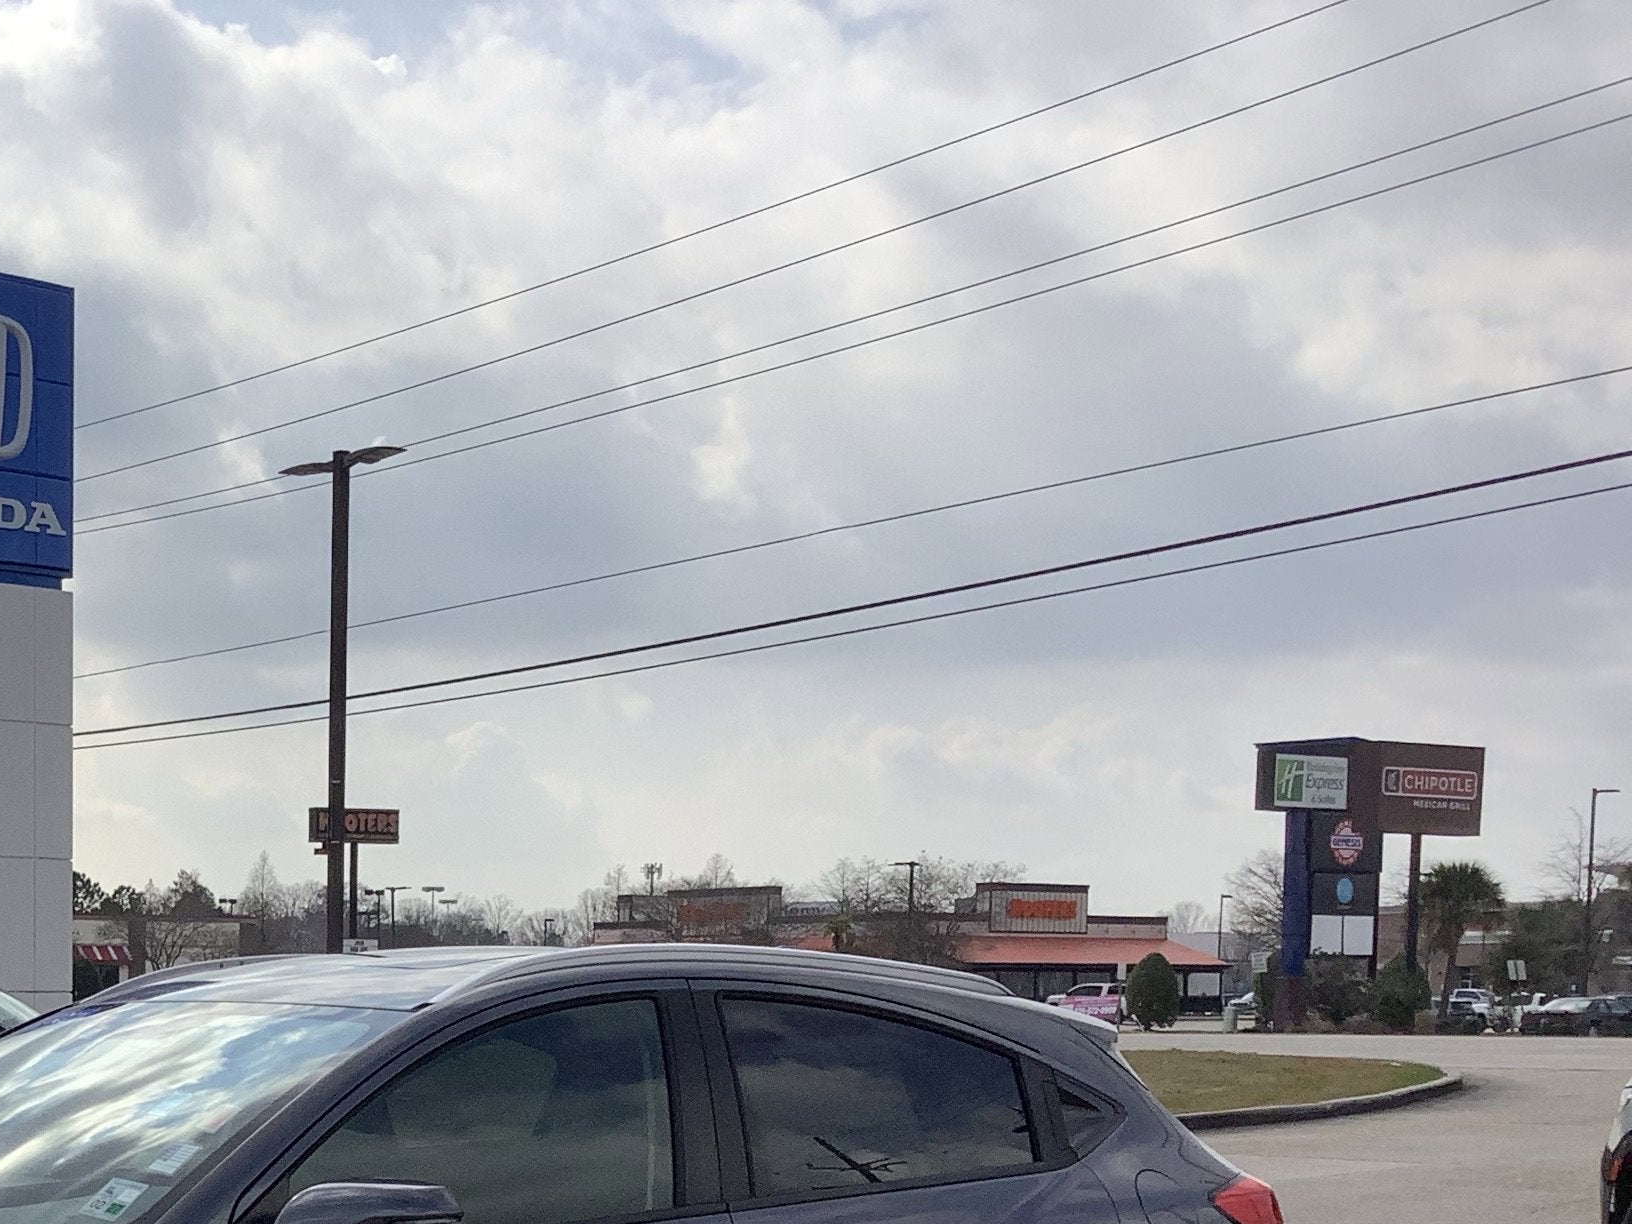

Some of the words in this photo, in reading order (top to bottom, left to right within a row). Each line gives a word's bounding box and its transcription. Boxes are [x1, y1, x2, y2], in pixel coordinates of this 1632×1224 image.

[1306, 773, 1344, 790] Express
[1404, 774, 1474, 793] CHIPOTLE
[318, 811, 398, 832] HOTERS
